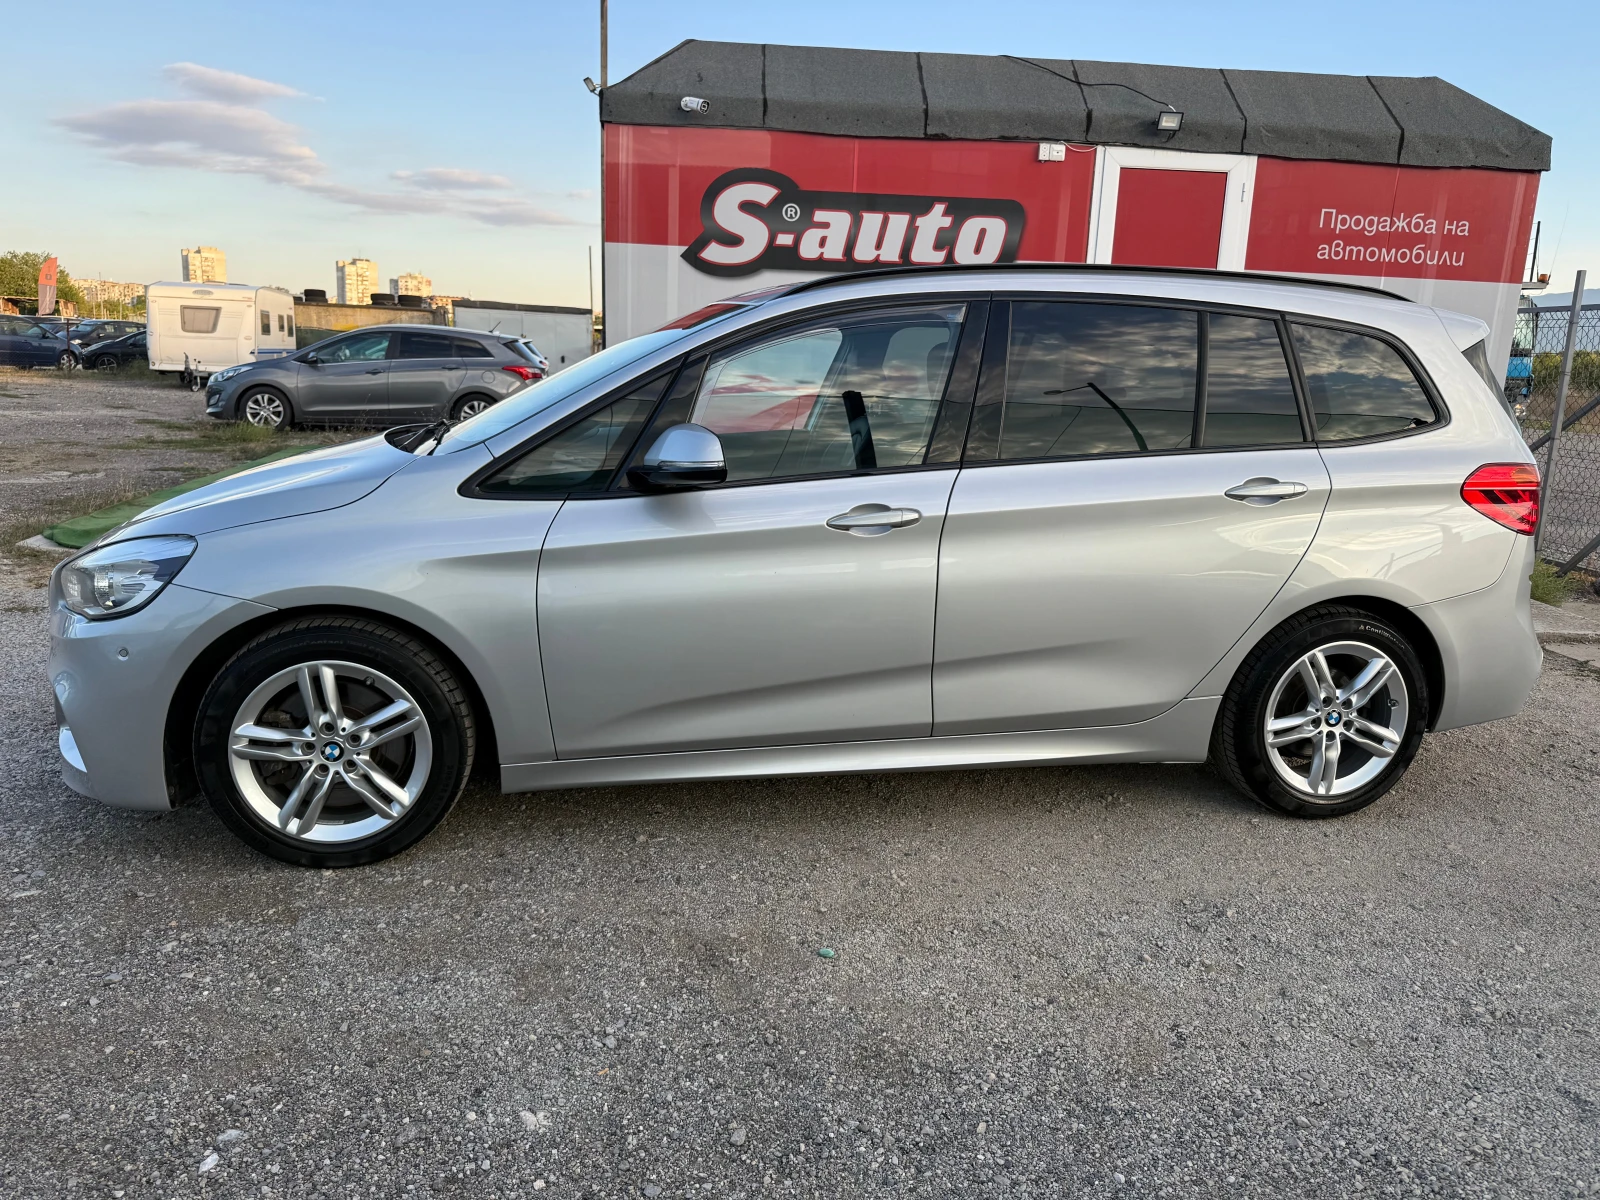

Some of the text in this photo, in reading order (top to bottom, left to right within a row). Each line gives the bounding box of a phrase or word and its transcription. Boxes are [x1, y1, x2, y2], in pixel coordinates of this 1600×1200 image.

[1319, 208, 1469, 236] Продажба на
[1316, 240, 1465, 266] автомобили
